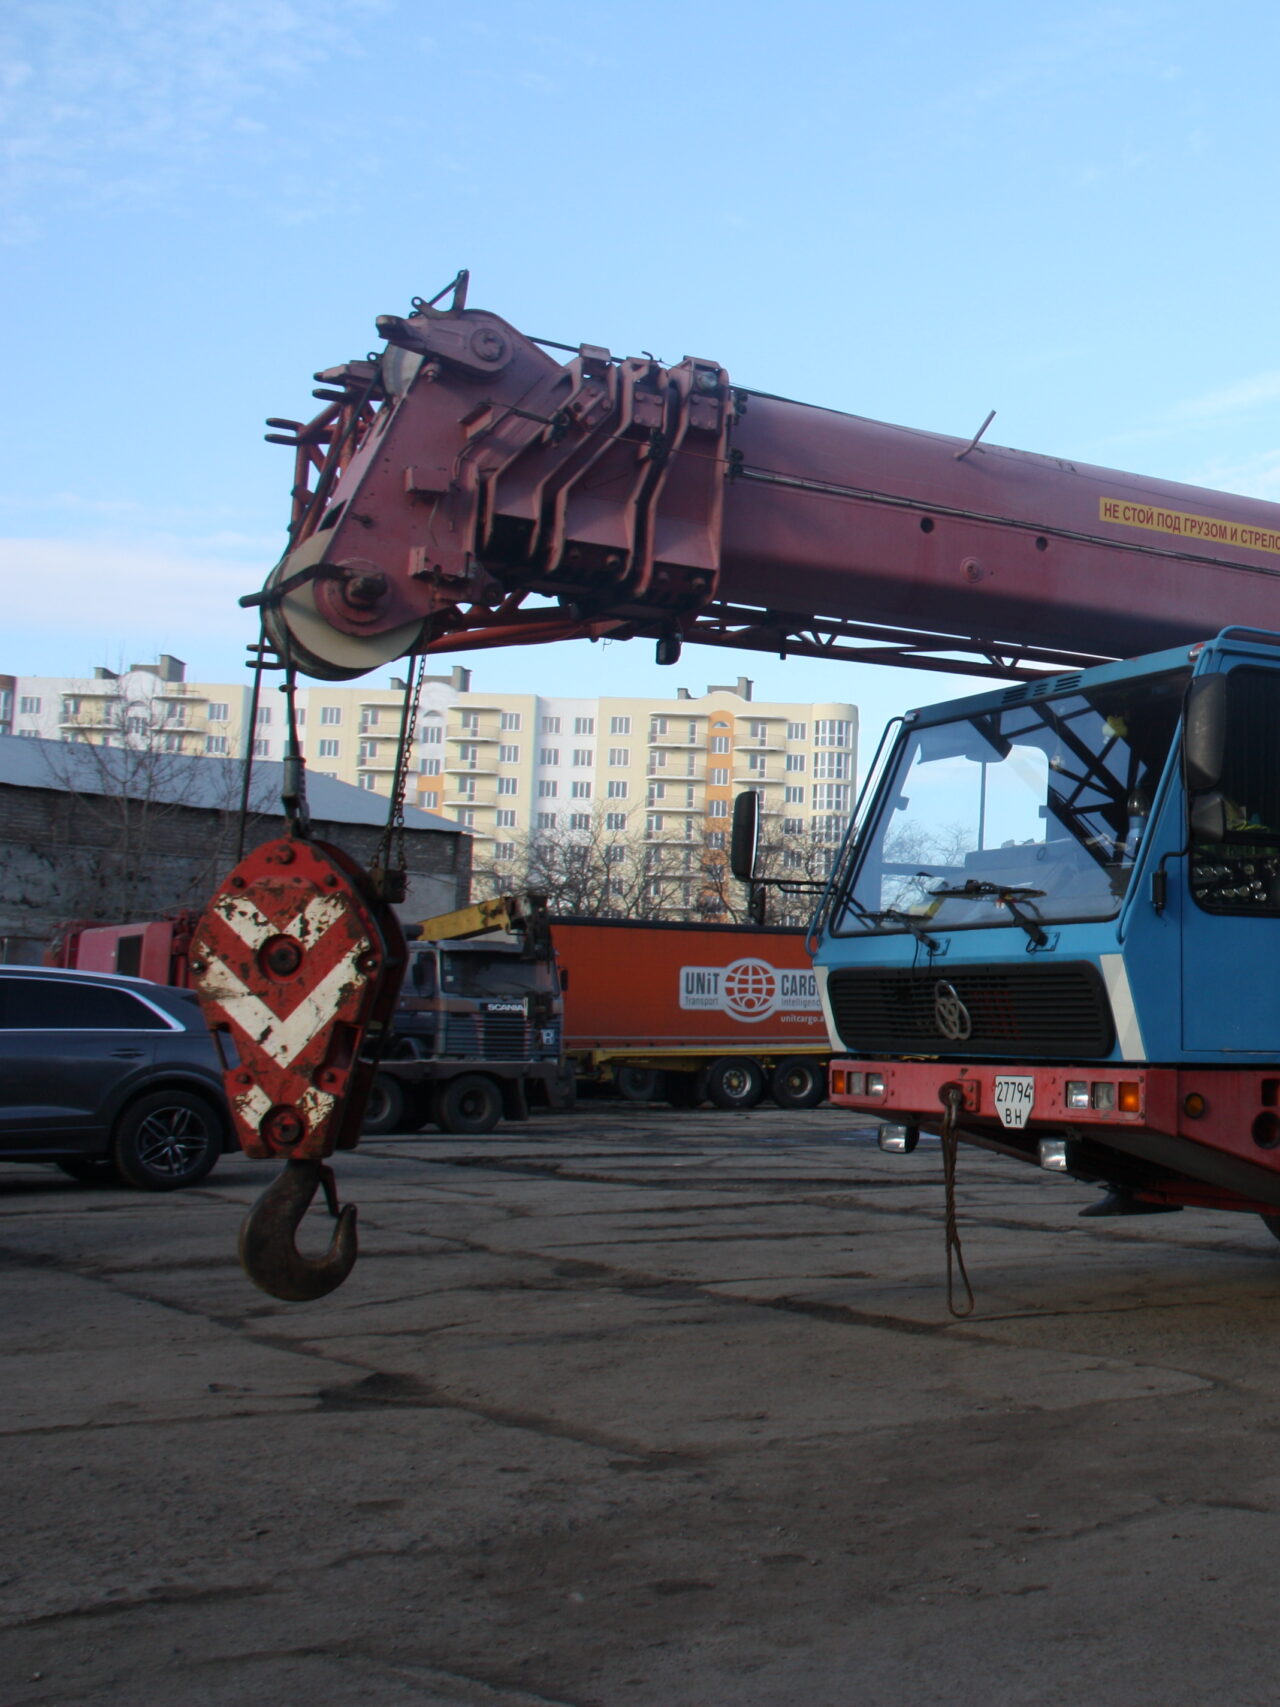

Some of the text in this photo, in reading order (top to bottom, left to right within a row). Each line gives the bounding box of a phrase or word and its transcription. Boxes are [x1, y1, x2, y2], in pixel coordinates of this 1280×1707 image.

[1104, 502, 1120, 519] НЕ
[1123, 506, 1154, 526] СТОЙ
[1157, 512, 1181, 533] ПОД
[1184, 517, 1227, 540] ГРУЗОМ
[1230, 528, 1238, 541] И
[781, 974, 819, 996] CARG
[487, 1003, 526, 1012] SCANIA
[685, 996, 822, 1008] Transport Intelligenc
[997, 1082, 1032, 1103] 27794
